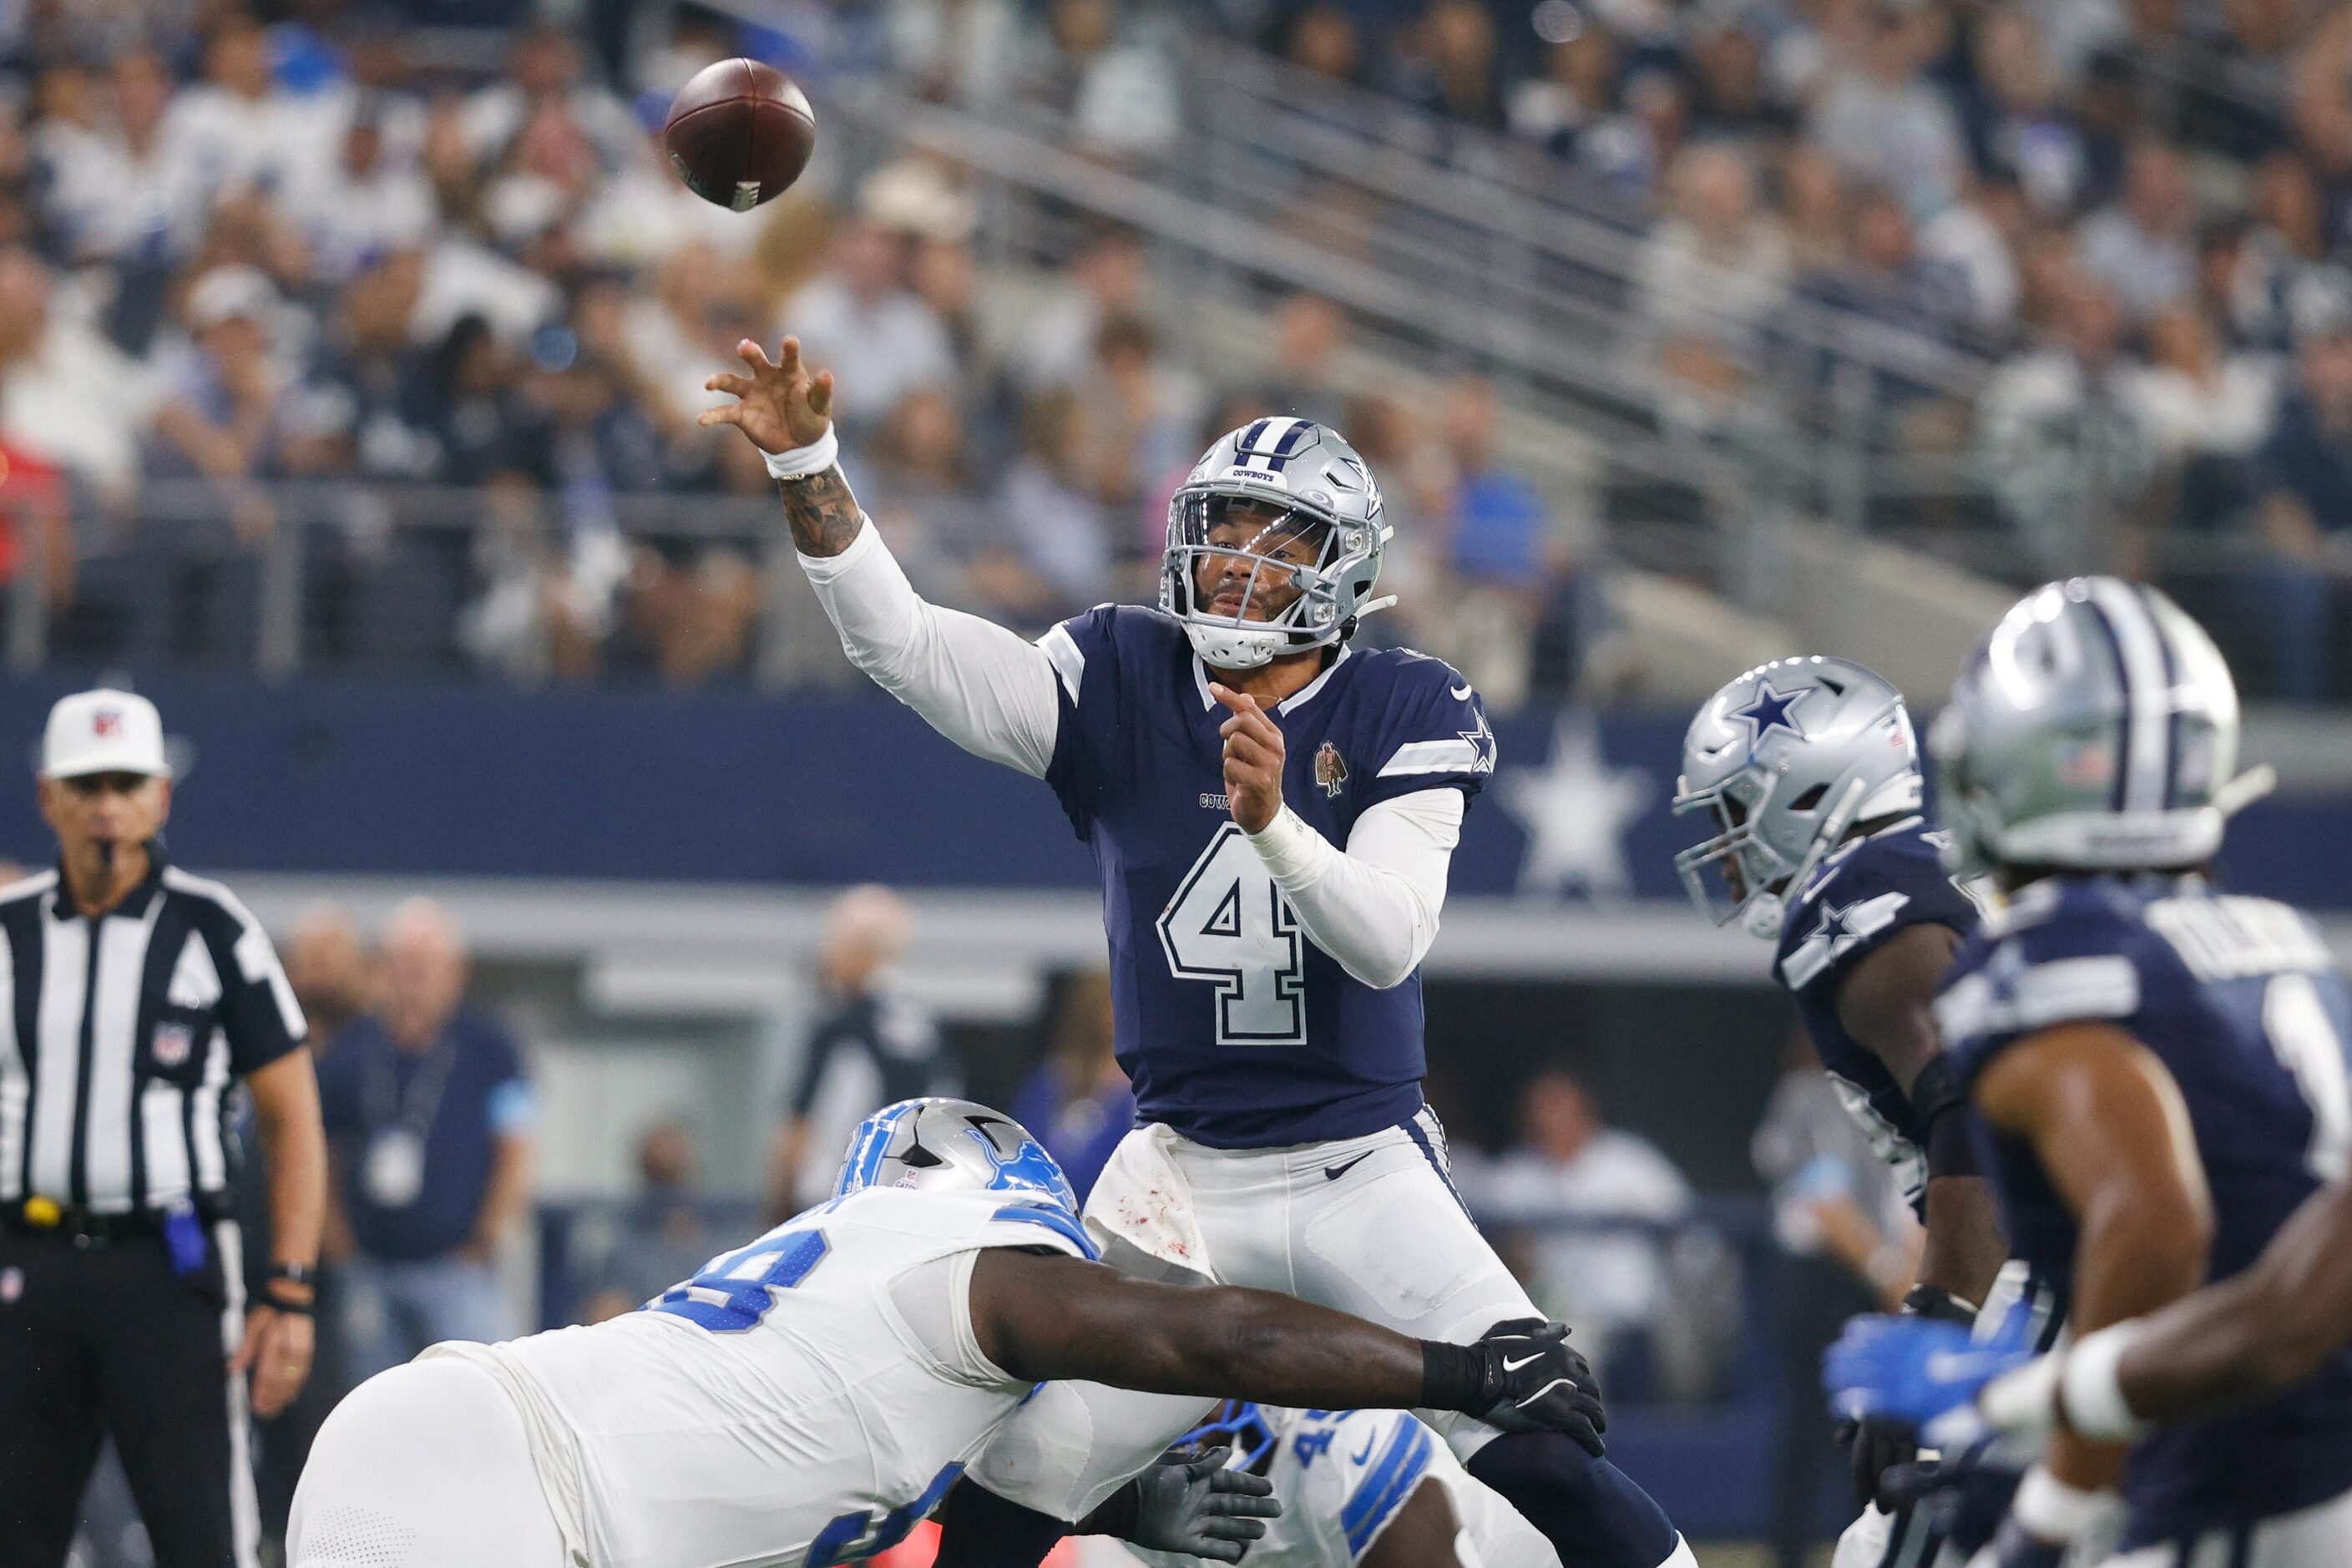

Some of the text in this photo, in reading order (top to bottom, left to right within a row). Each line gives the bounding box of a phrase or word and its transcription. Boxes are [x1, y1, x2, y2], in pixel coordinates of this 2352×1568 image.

[1232, 469, 1275, 483] COWBOYS
[1156, 820, 1308, 1046] 4
[637, 1227, 832, 1334] 8
